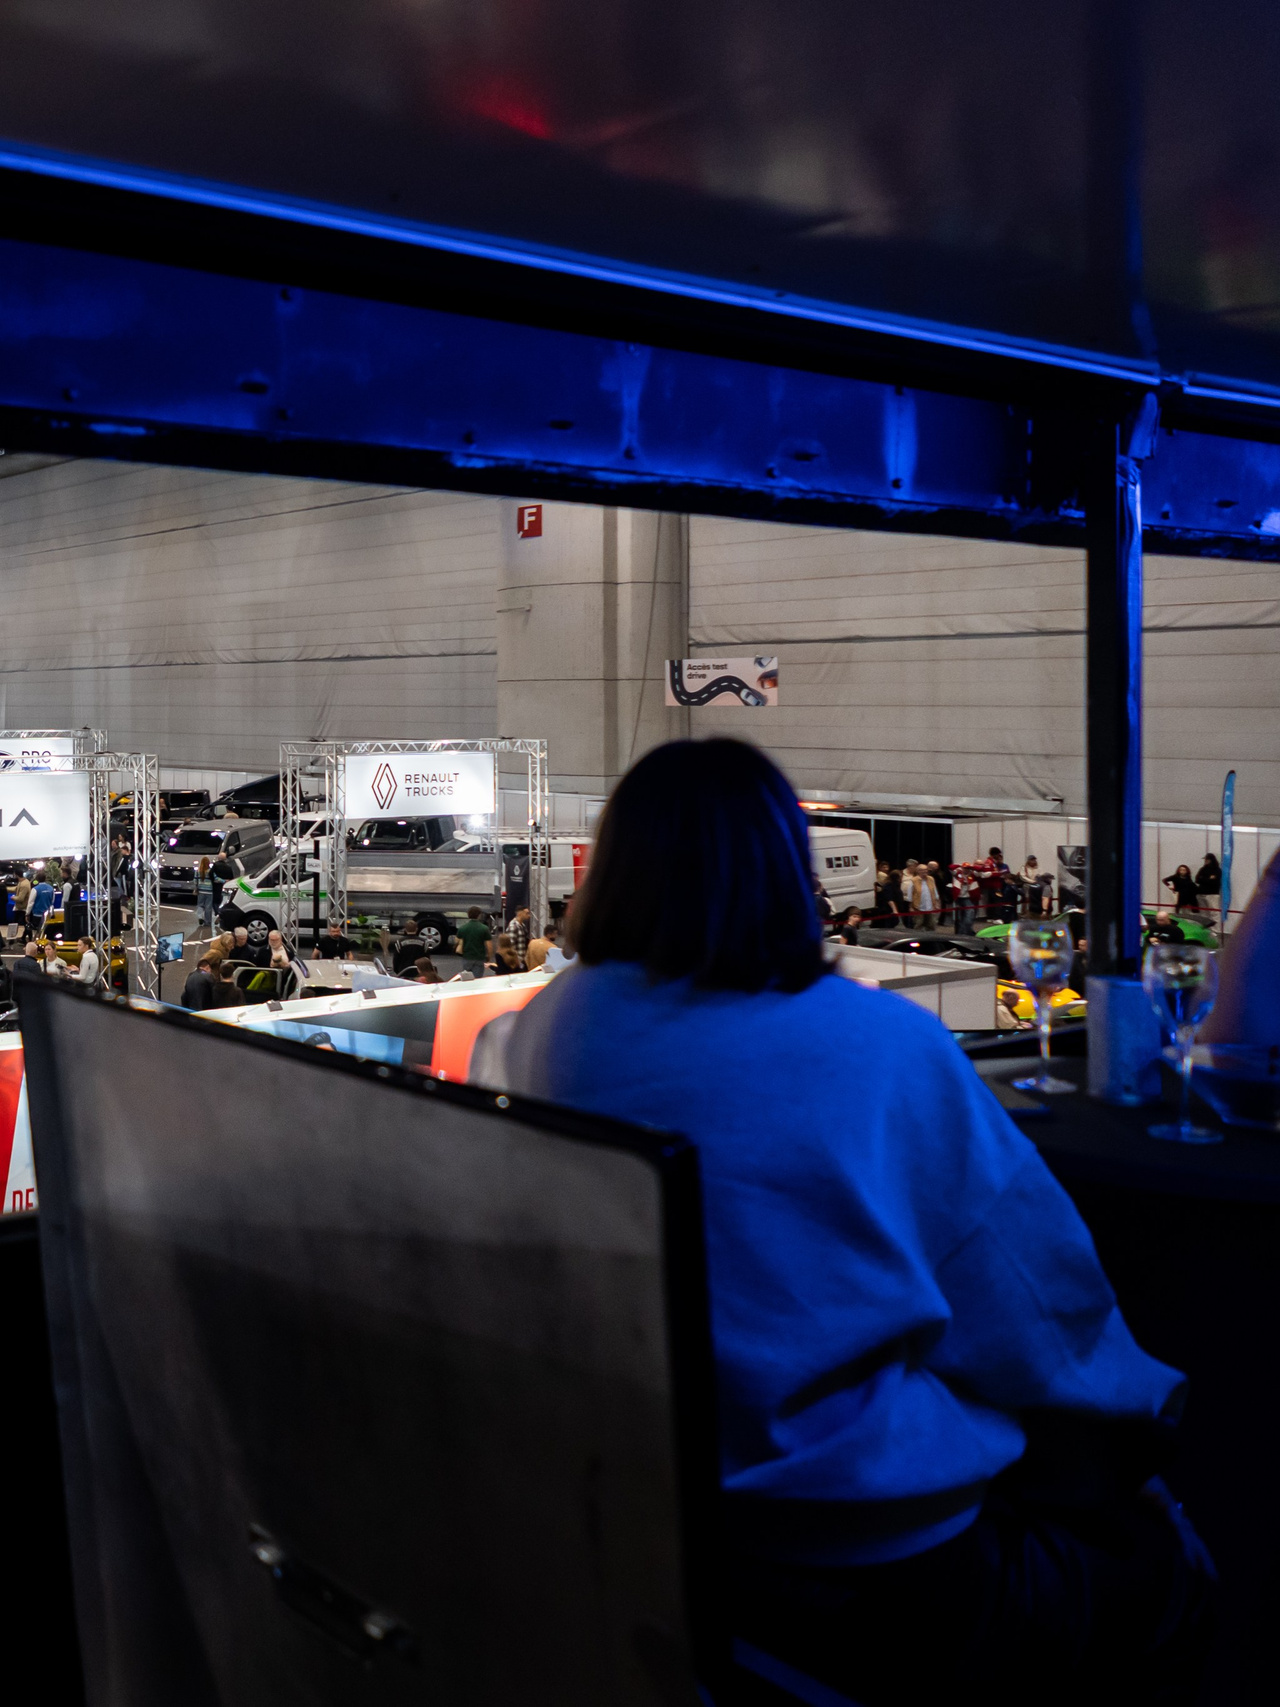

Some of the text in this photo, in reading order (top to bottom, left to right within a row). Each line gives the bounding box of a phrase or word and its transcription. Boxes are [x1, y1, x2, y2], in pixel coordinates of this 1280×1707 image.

[524, 507, 538, 531] F
[687, 662, 728, 671] Accès test
[687, 671, 707, 680] drive
[21, 750, 52, 764] PRO
[405, 772, 459, 784] RENAULT
[405, 786, 454, 797] TRUCKS
